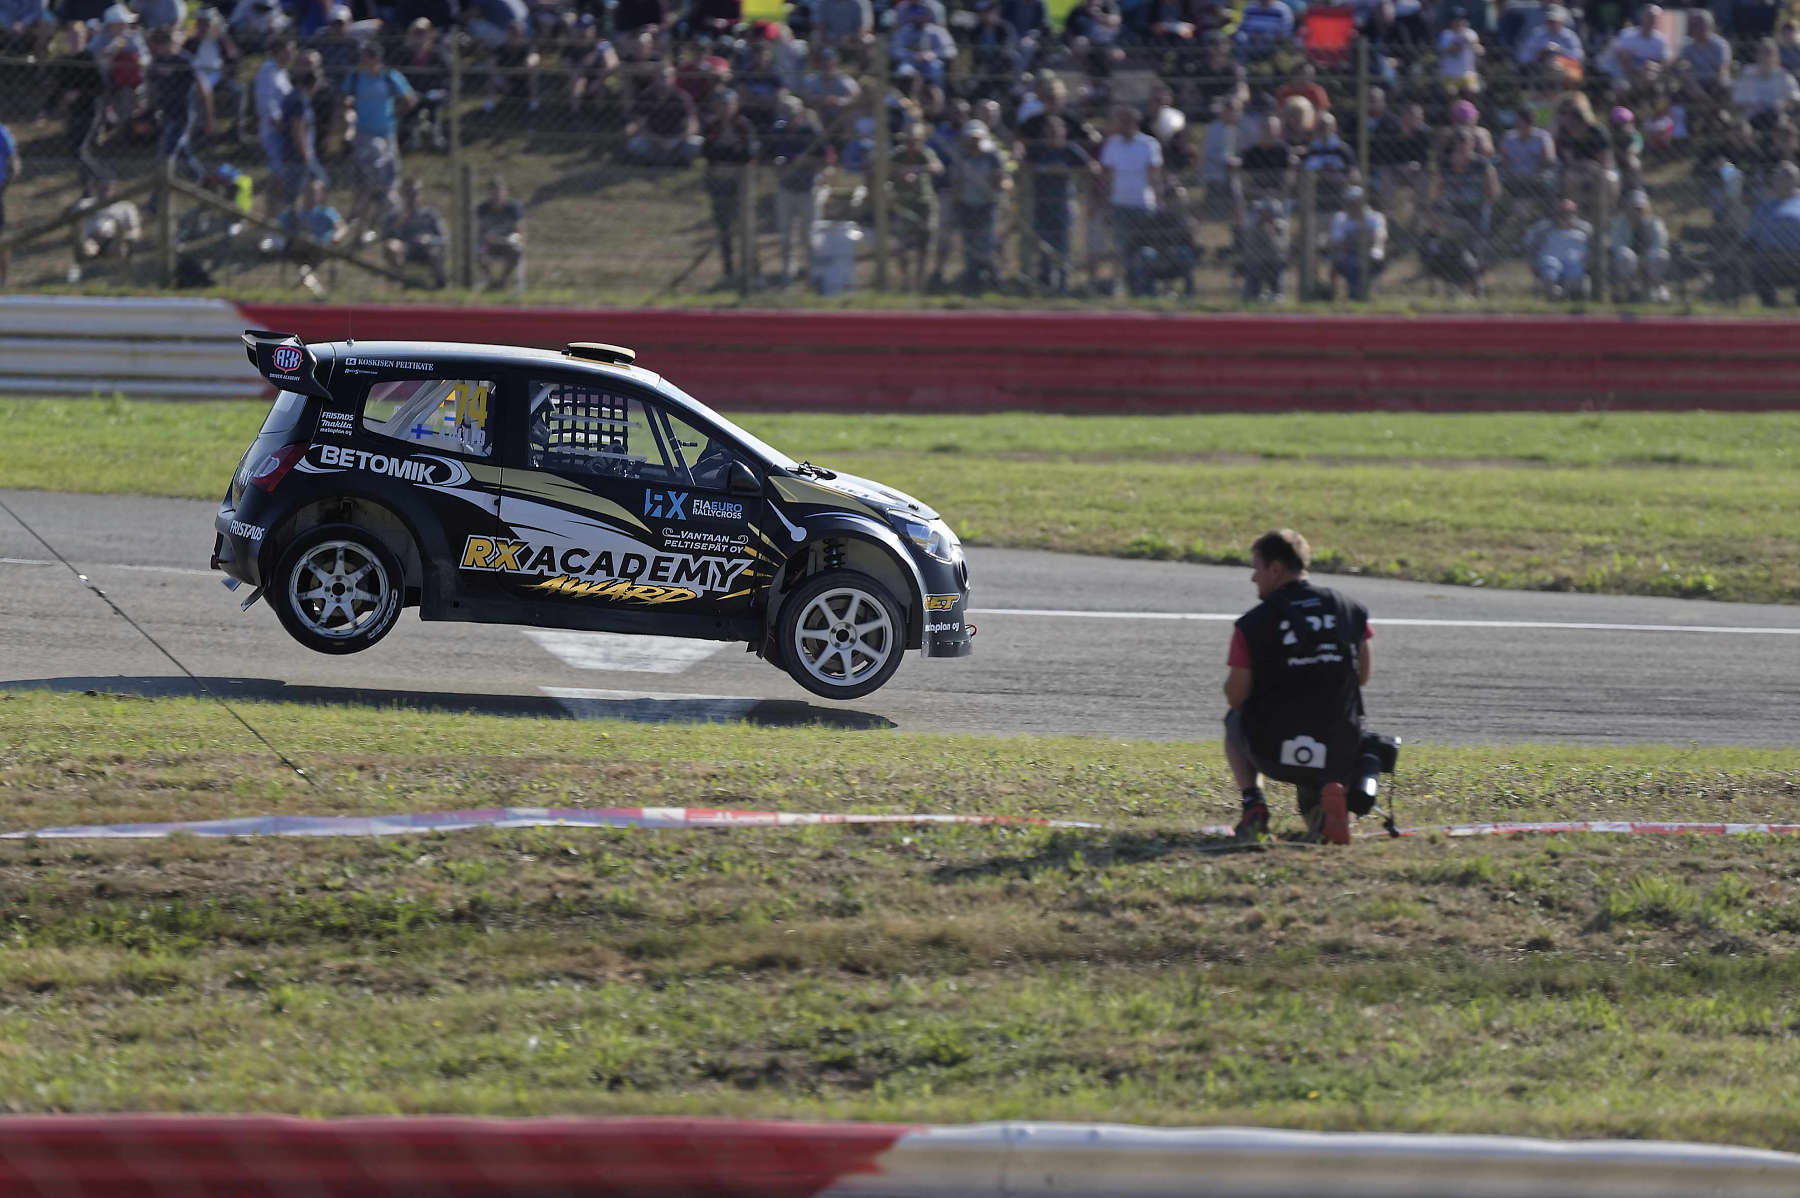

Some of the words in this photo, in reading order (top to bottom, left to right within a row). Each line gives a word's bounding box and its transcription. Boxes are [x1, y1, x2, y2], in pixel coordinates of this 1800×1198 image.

[358, 359, 394, 368] KOSKISEN
[396, 361, 433, 371] PELTIKATE
[455, 383, 488, 428] 74
[321, 411, 353, 421] FRISTADS
[320, 444, 437, 485] BETOMIK
[692, 508, 742, 520] RALLYCROSS
[229, 520, 265, 541] FRISTADS
[680, 530, 730, 543] VANTAAN
[664, 539, 728, 552] PELTISEPÄT
[729, 546, 744, 554] OY
